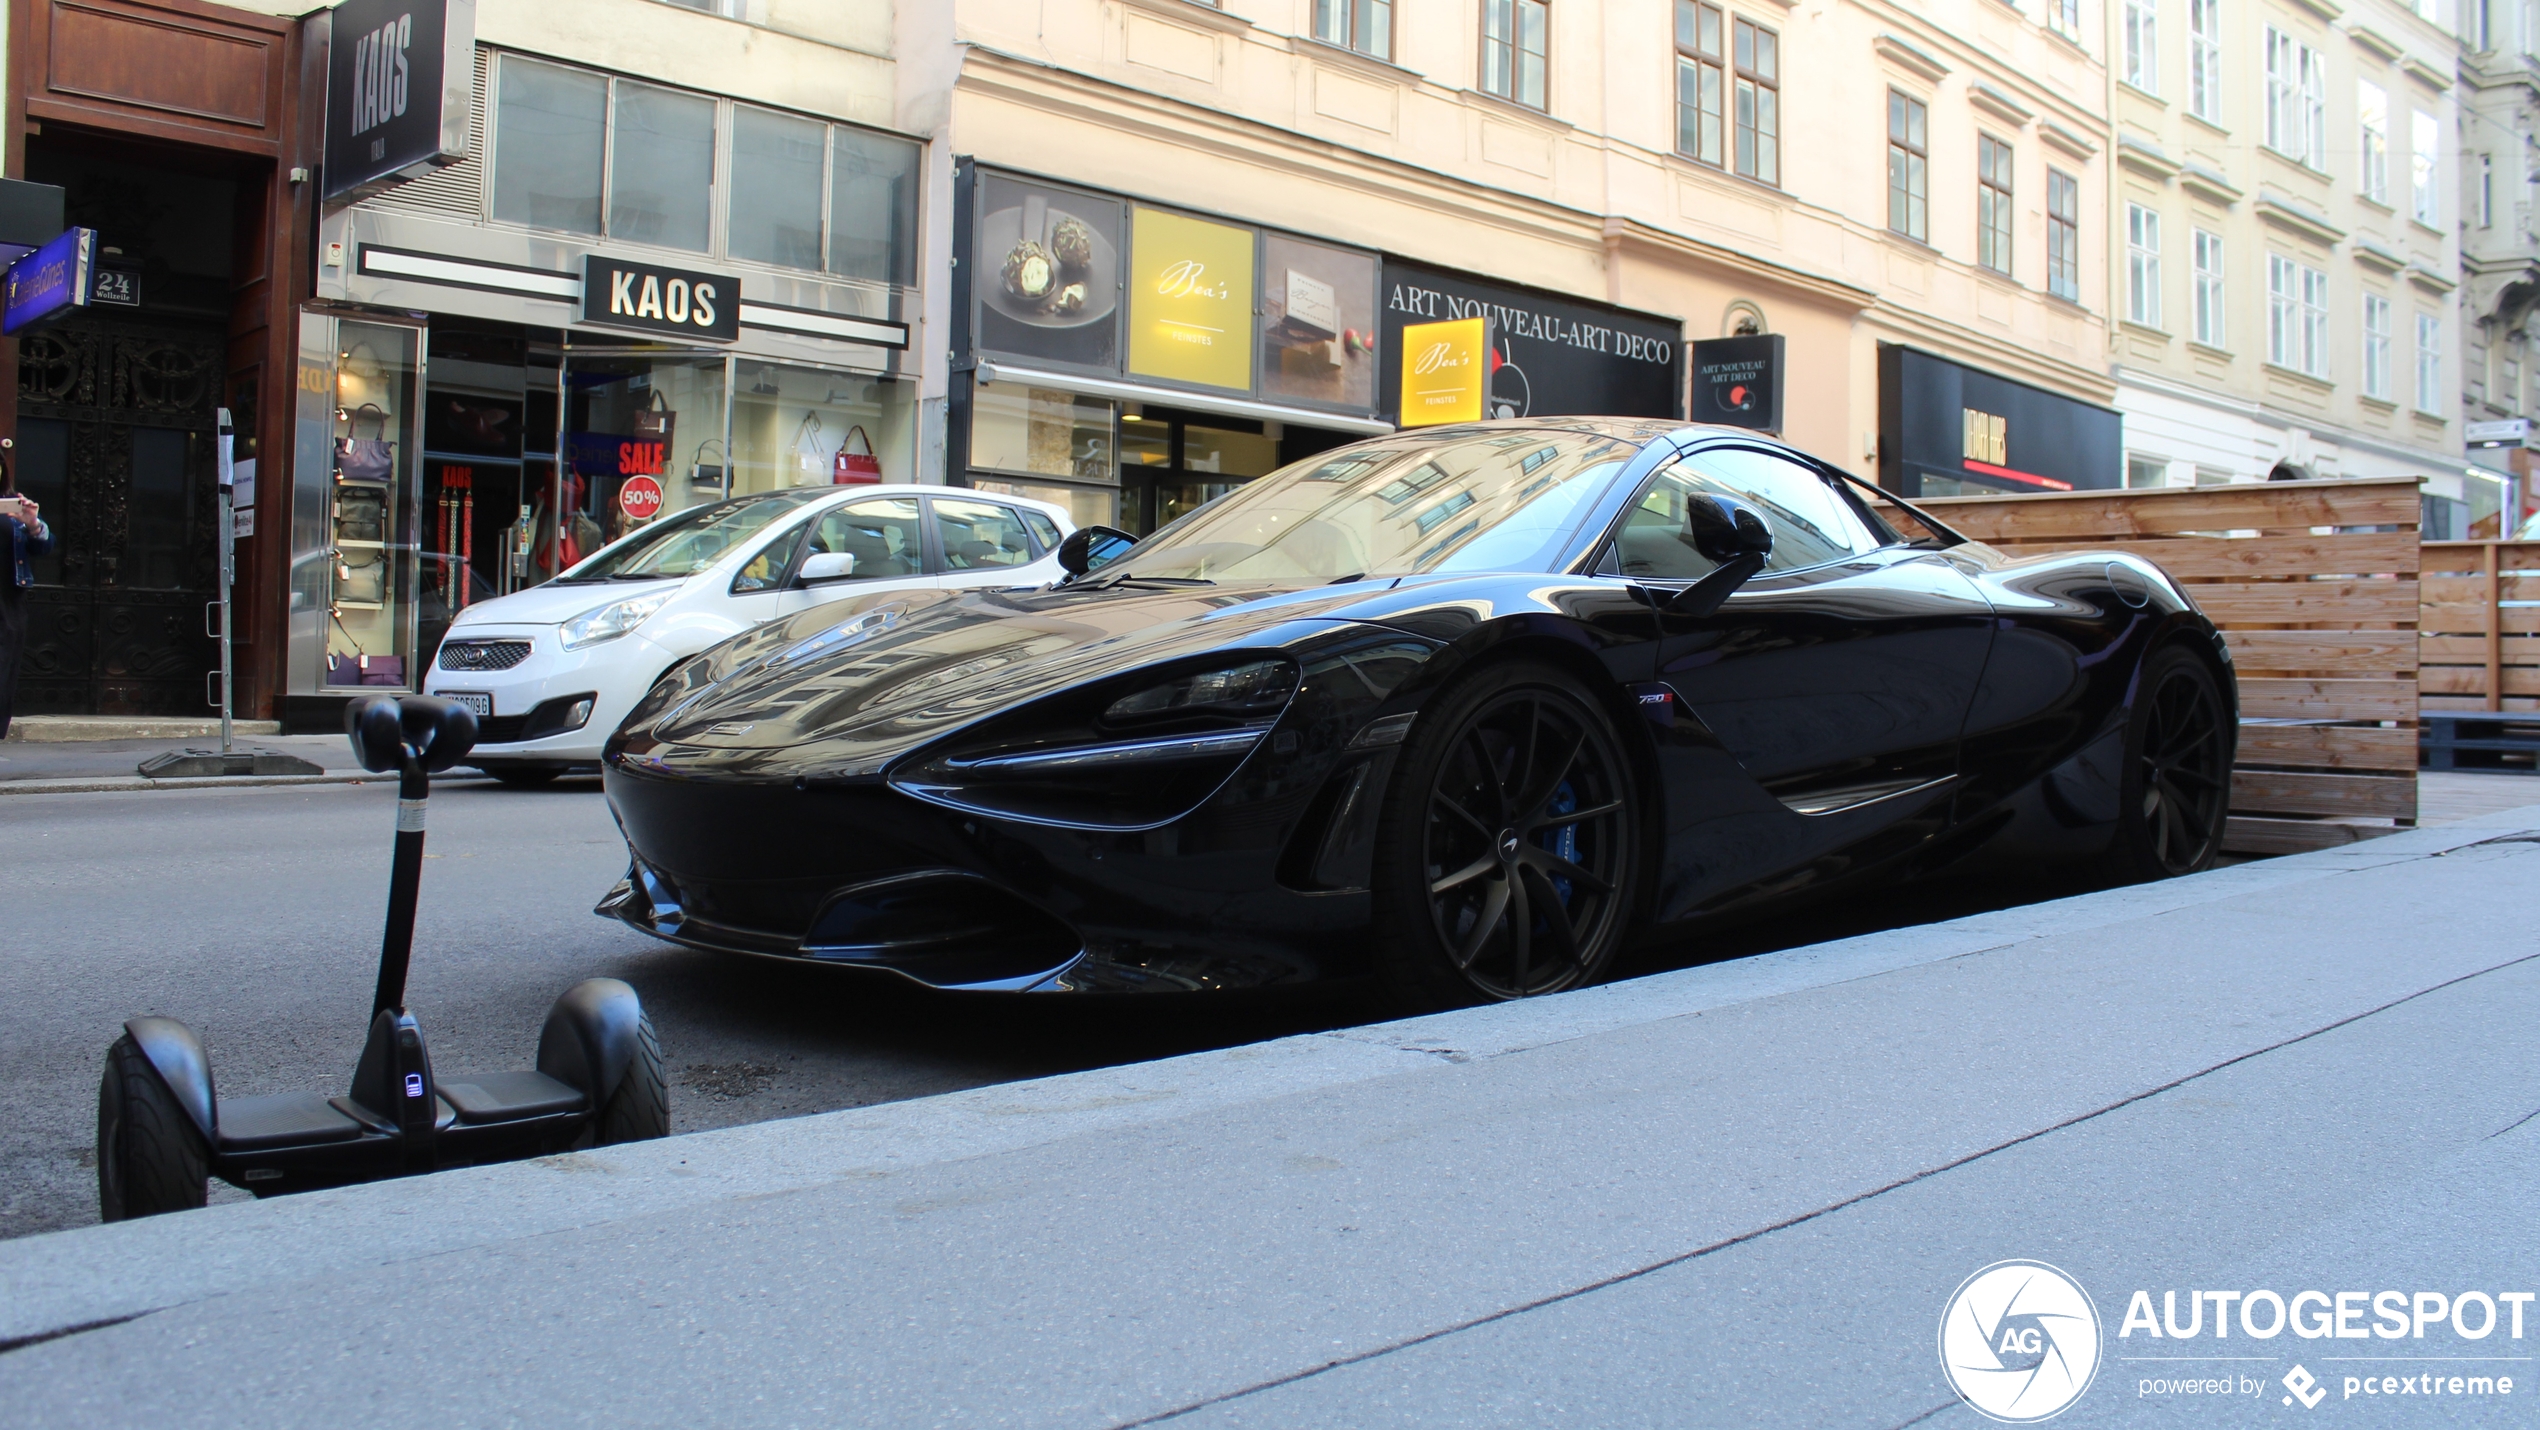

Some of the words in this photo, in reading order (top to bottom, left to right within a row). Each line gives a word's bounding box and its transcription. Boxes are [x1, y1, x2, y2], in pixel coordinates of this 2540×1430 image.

[352, 13, 411, 137] KAOS
[98, 272, 129, 294] 24
[1158, 259, 1228, 300] Bea's
[96, 290, 131, 301] Wollzeile
[610, 269, 716, 327] KAOS
[1389, 283, 1441, 318] ART
[1615, 330, 1671, 365] DECO
[1171, 330, 1213, 346] FEINSTES
[1414, 342, 1470, 375] Bea's
[1701, 364, 1720, 375] ART
[1721, 360, 1767, 373] NOUVEAU
[1710, 373, 1730, 384] ART
[1731, 371, 1757, 382] DECO
[1424, 395, 1458, 406] FEINSTES
[618, 441, 665, 475] SALE
[442, 465, 472, 488] KAOS
[624, 490, 660, 505] 50%
[1639, 693, 1674, 704] 720S
